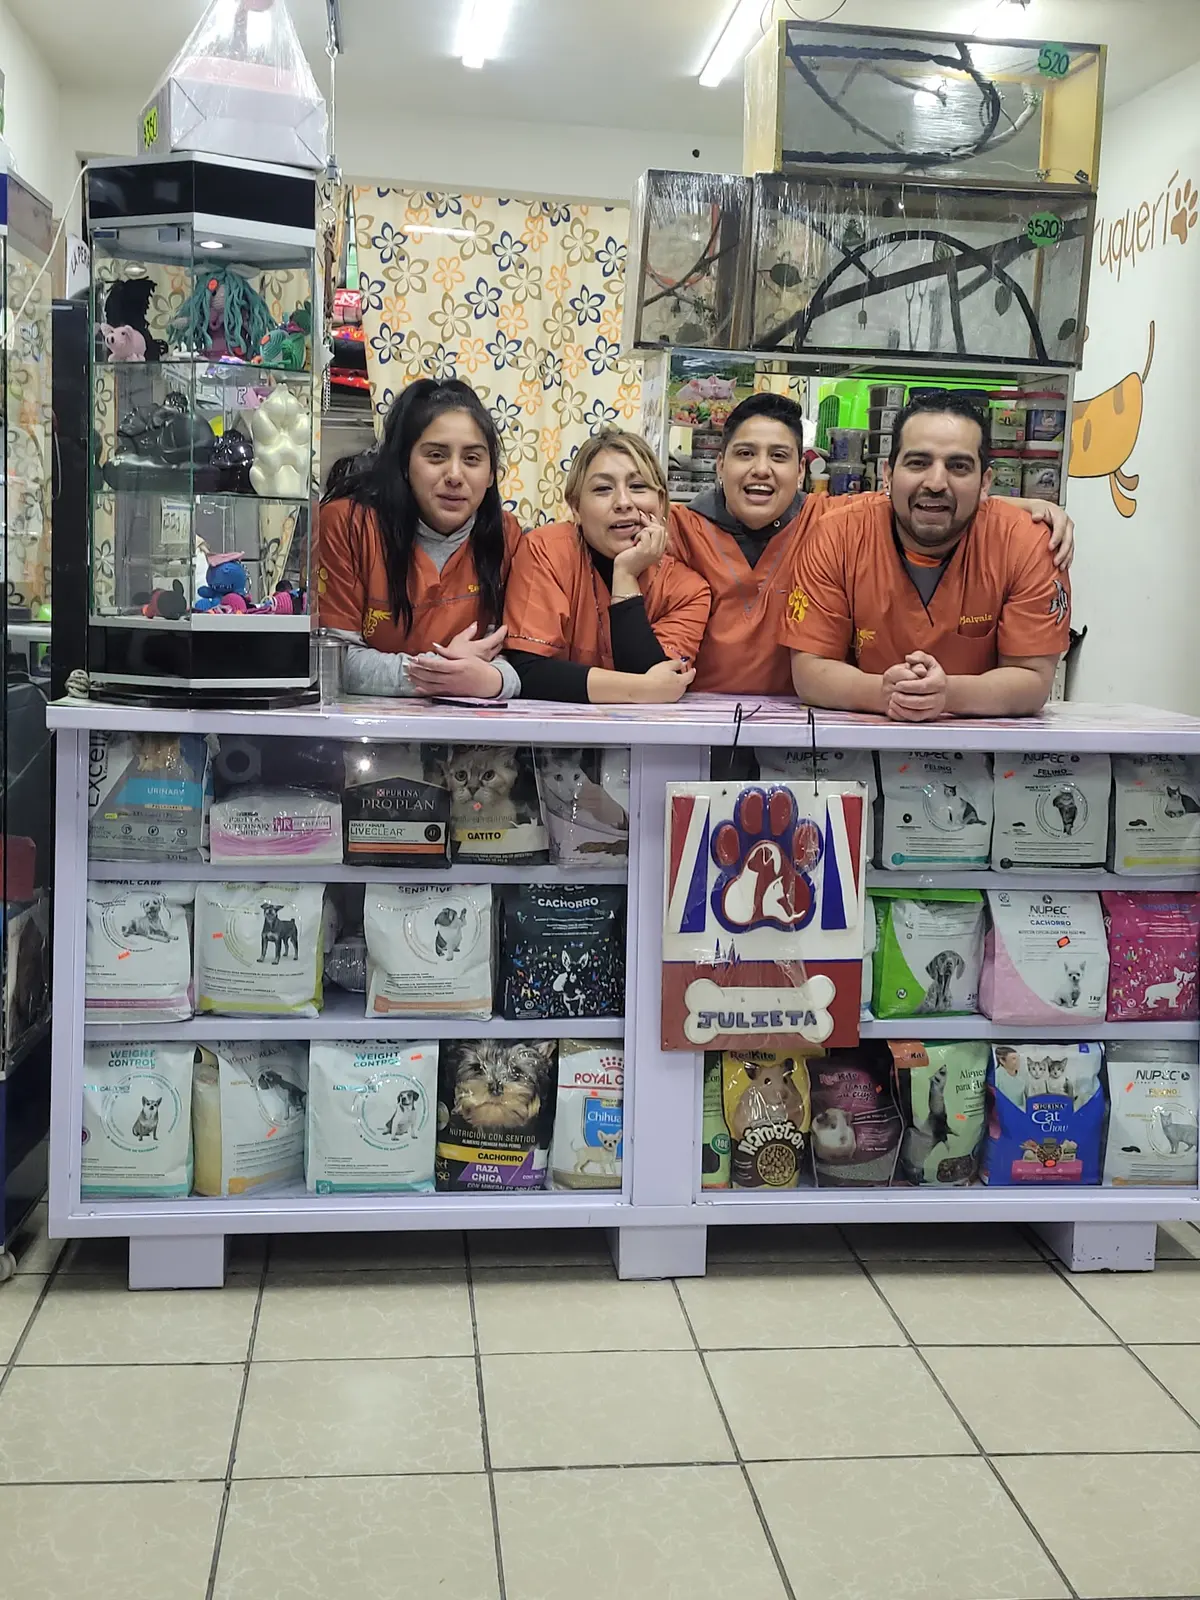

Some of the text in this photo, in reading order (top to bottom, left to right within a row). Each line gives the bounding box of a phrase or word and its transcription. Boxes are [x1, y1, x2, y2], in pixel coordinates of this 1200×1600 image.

[1027, 219, 1060, 239] $520
[147, 787, 184, 796] URINARY
[386, 789, 418, 797] PURINA
[362, 799, 436, 811] PRO PLAN
[467, 832, 502, 840] GATITO
[538, 897, 599, 909] CACHORRO
[1030, 905, 1068, 915] NUPEC
[697, 1010, 818, 1029] JULIETA
[110, 1049, 156, 1059] WEIGHT
[355, 1050, 400, 1060] WEIGHT
[574, 1072, 613, 1085] ROYAL
[955, 1083, 972, 1095] para
[1038, 1102, 1065, 1110] PURINA
[1031, 1109, 1062, 1125] Cat
[1041, 1121, 1069, 1133] Chow
[488, 1133, 504, 1142] CON
[505, 1134, 536, 1144] SENTIDO
[477, 1152, 524, 1163] CACHORRO
[475, 1164, 499, 1174] RAZA
[471, 1173, 503, 1184] CHICA
